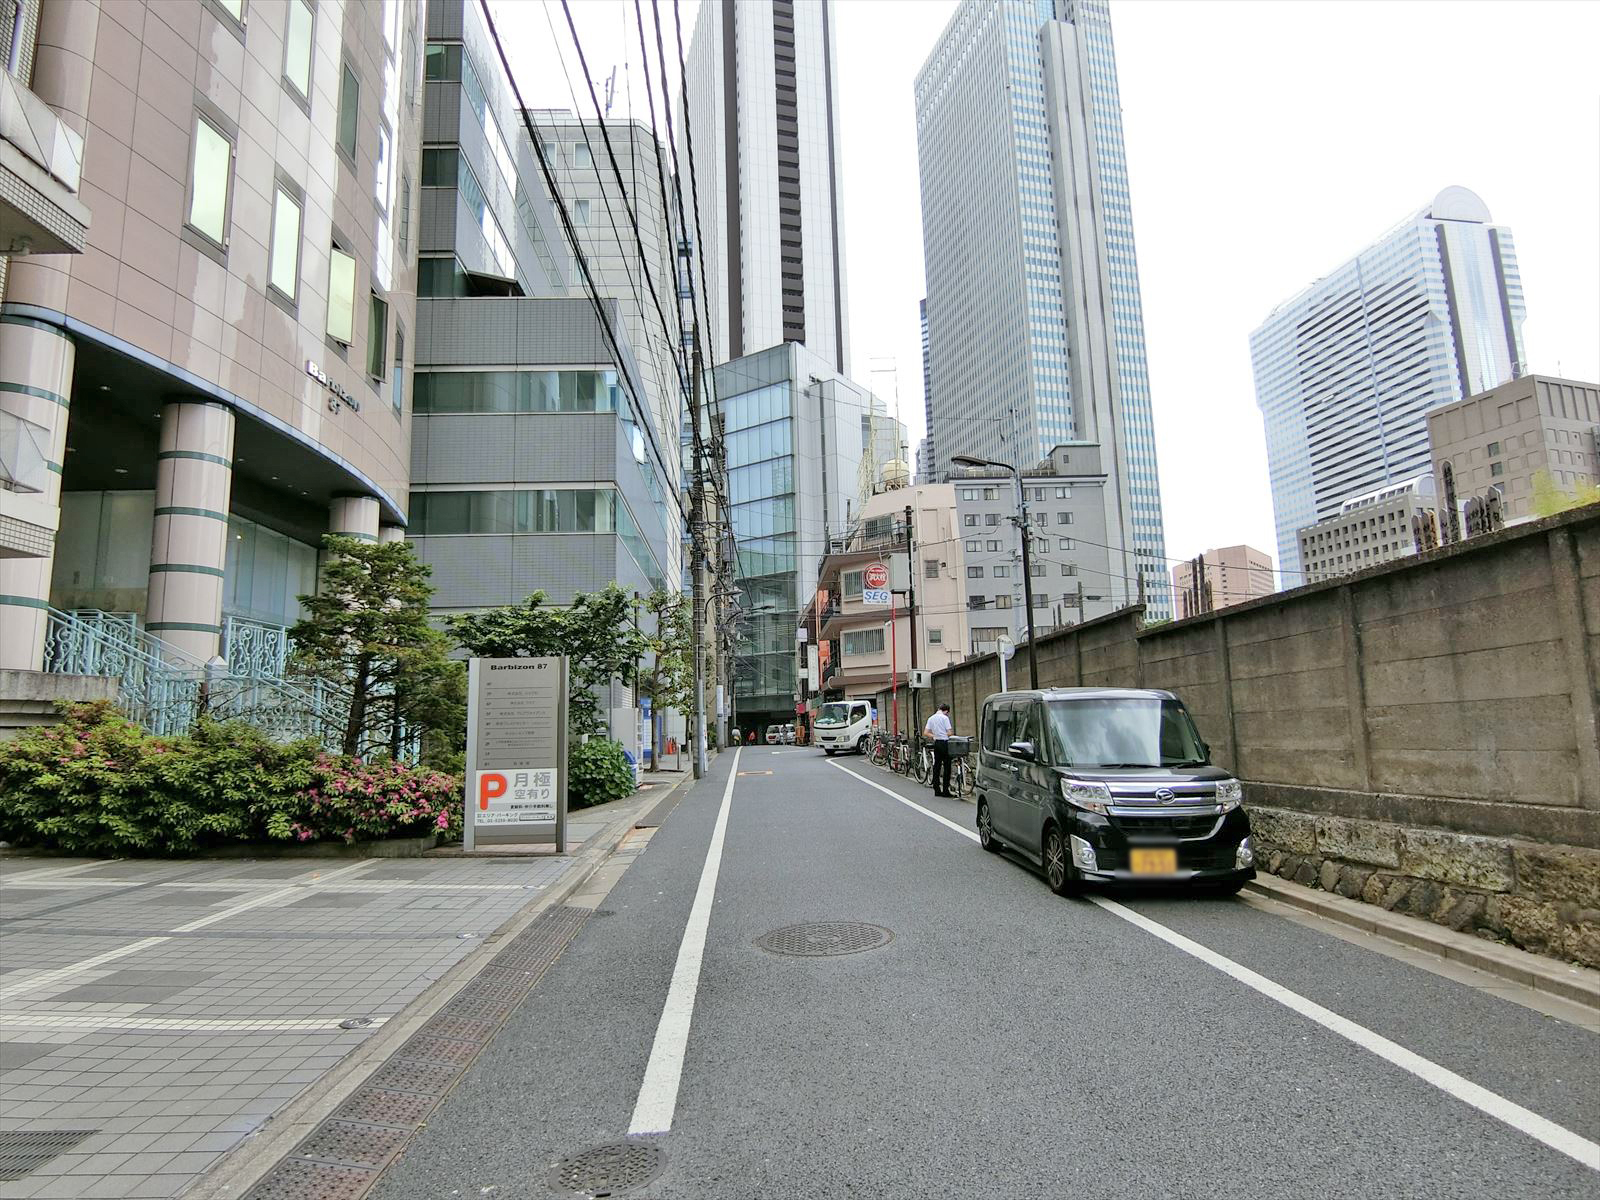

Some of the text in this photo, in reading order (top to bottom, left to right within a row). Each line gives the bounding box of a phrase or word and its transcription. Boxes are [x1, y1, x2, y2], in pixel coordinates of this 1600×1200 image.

[865, 591, 888, 600] SEG
[513, 772, 551, 787] 月極
[480, 774, 507, 810] P
[514, 788, 550, 800] 空有り
